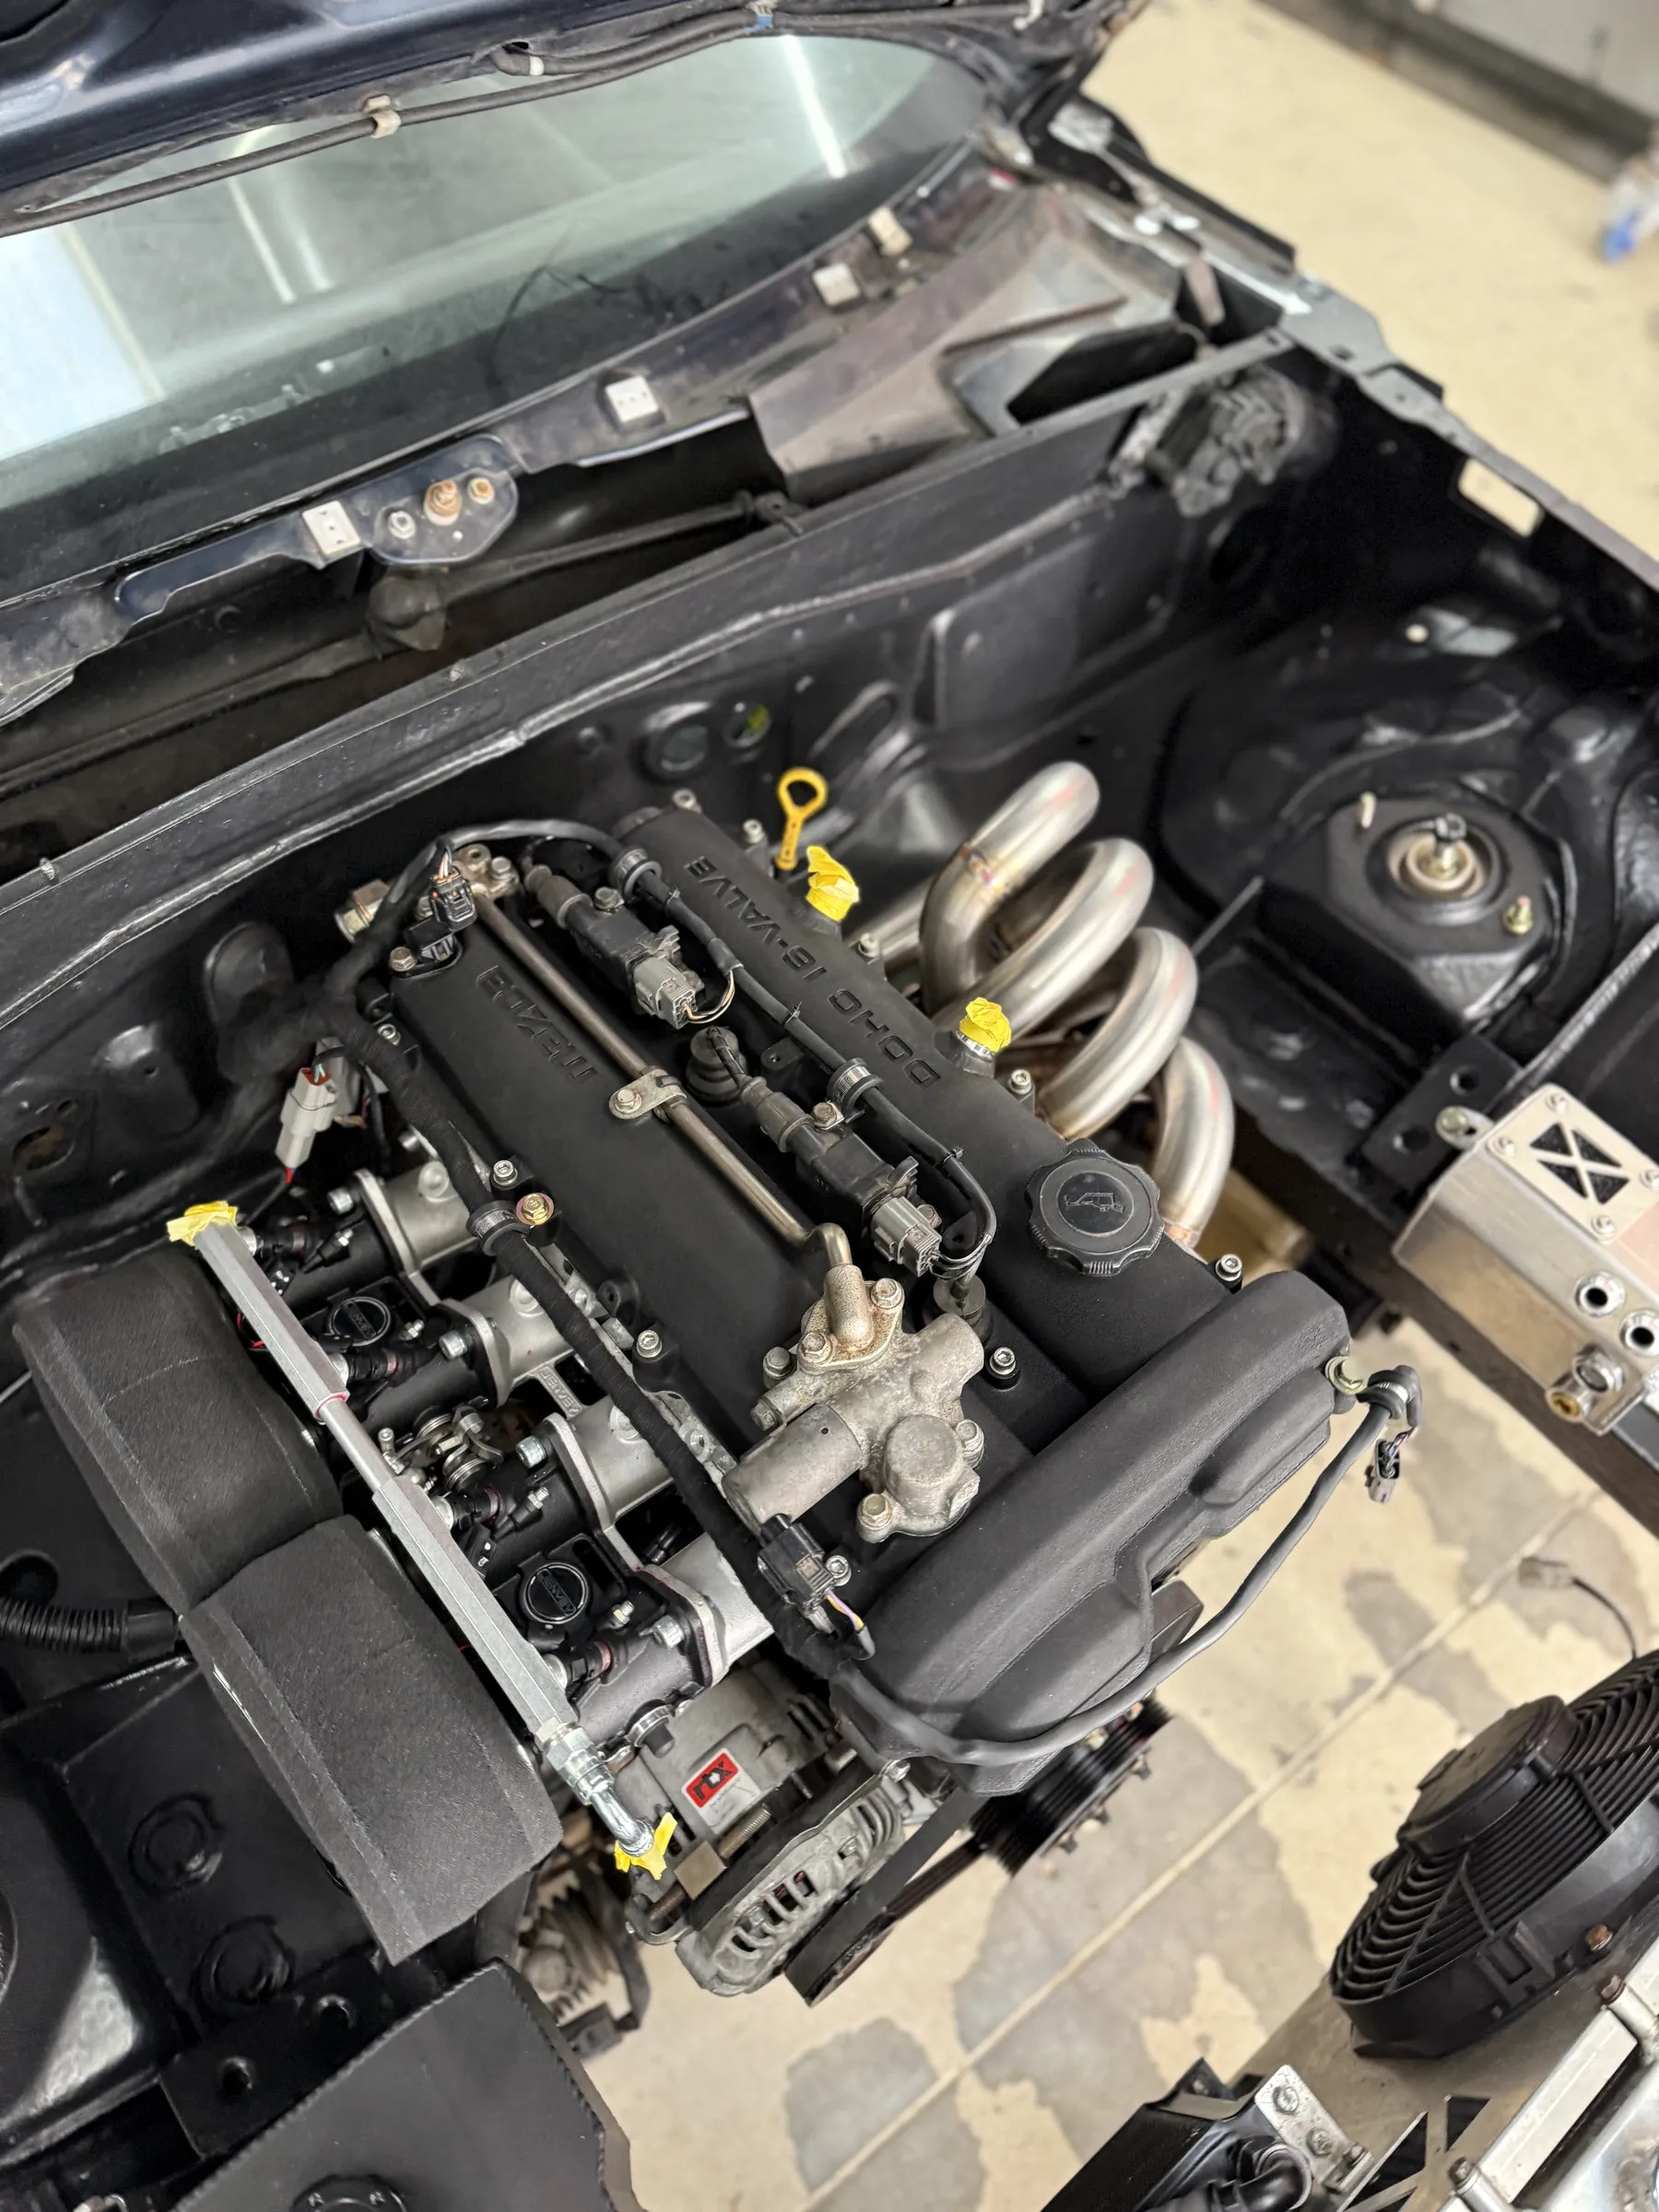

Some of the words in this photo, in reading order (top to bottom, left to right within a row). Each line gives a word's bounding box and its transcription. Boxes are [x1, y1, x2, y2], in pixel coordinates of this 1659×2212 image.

[684, 855, 828, 980] 16-VALVE
[827, 988, 941, 1088] DOHC
[539, 1370, 581, 1415] JENVEY
